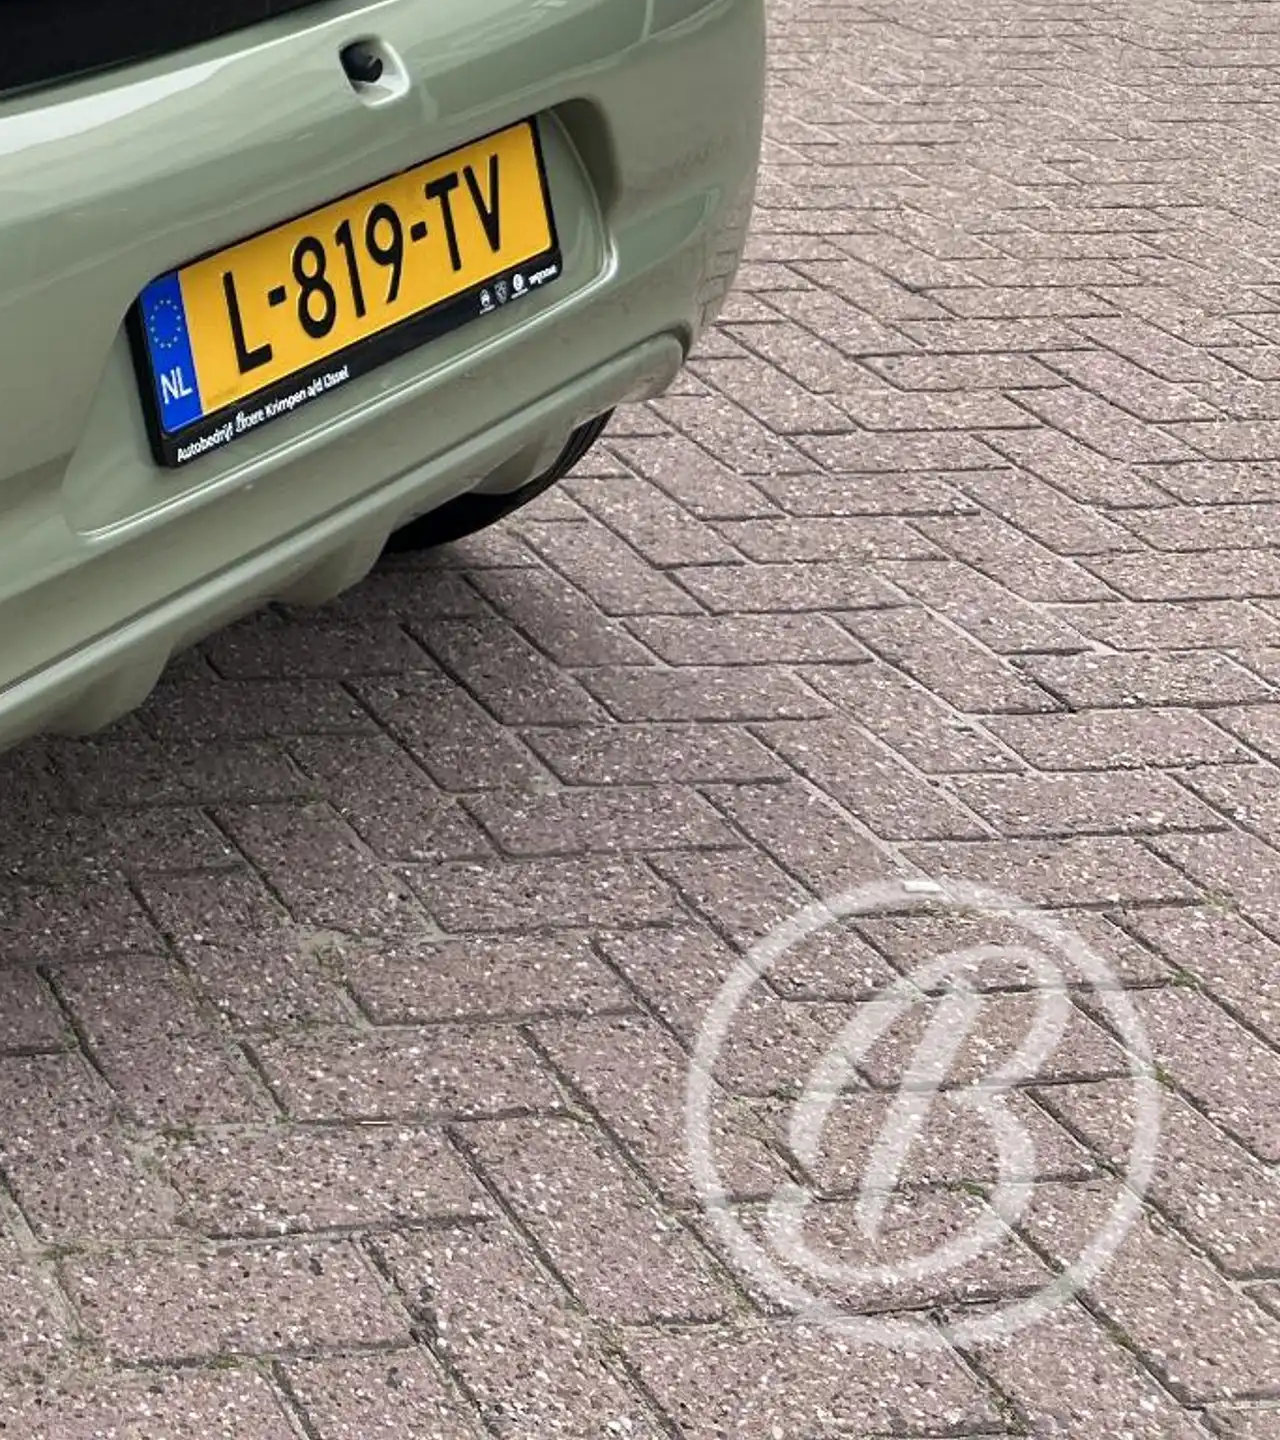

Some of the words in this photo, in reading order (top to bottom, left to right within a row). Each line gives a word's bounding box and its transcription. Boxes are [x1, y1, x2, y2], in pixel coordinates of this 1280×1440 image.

[223, 153, 500, 375] L-819-TV
[160, 366, 193, 405] NL
[176, 421, 233, 463] Autobedrijf
[265, 389, 308, 417] Krimpen
